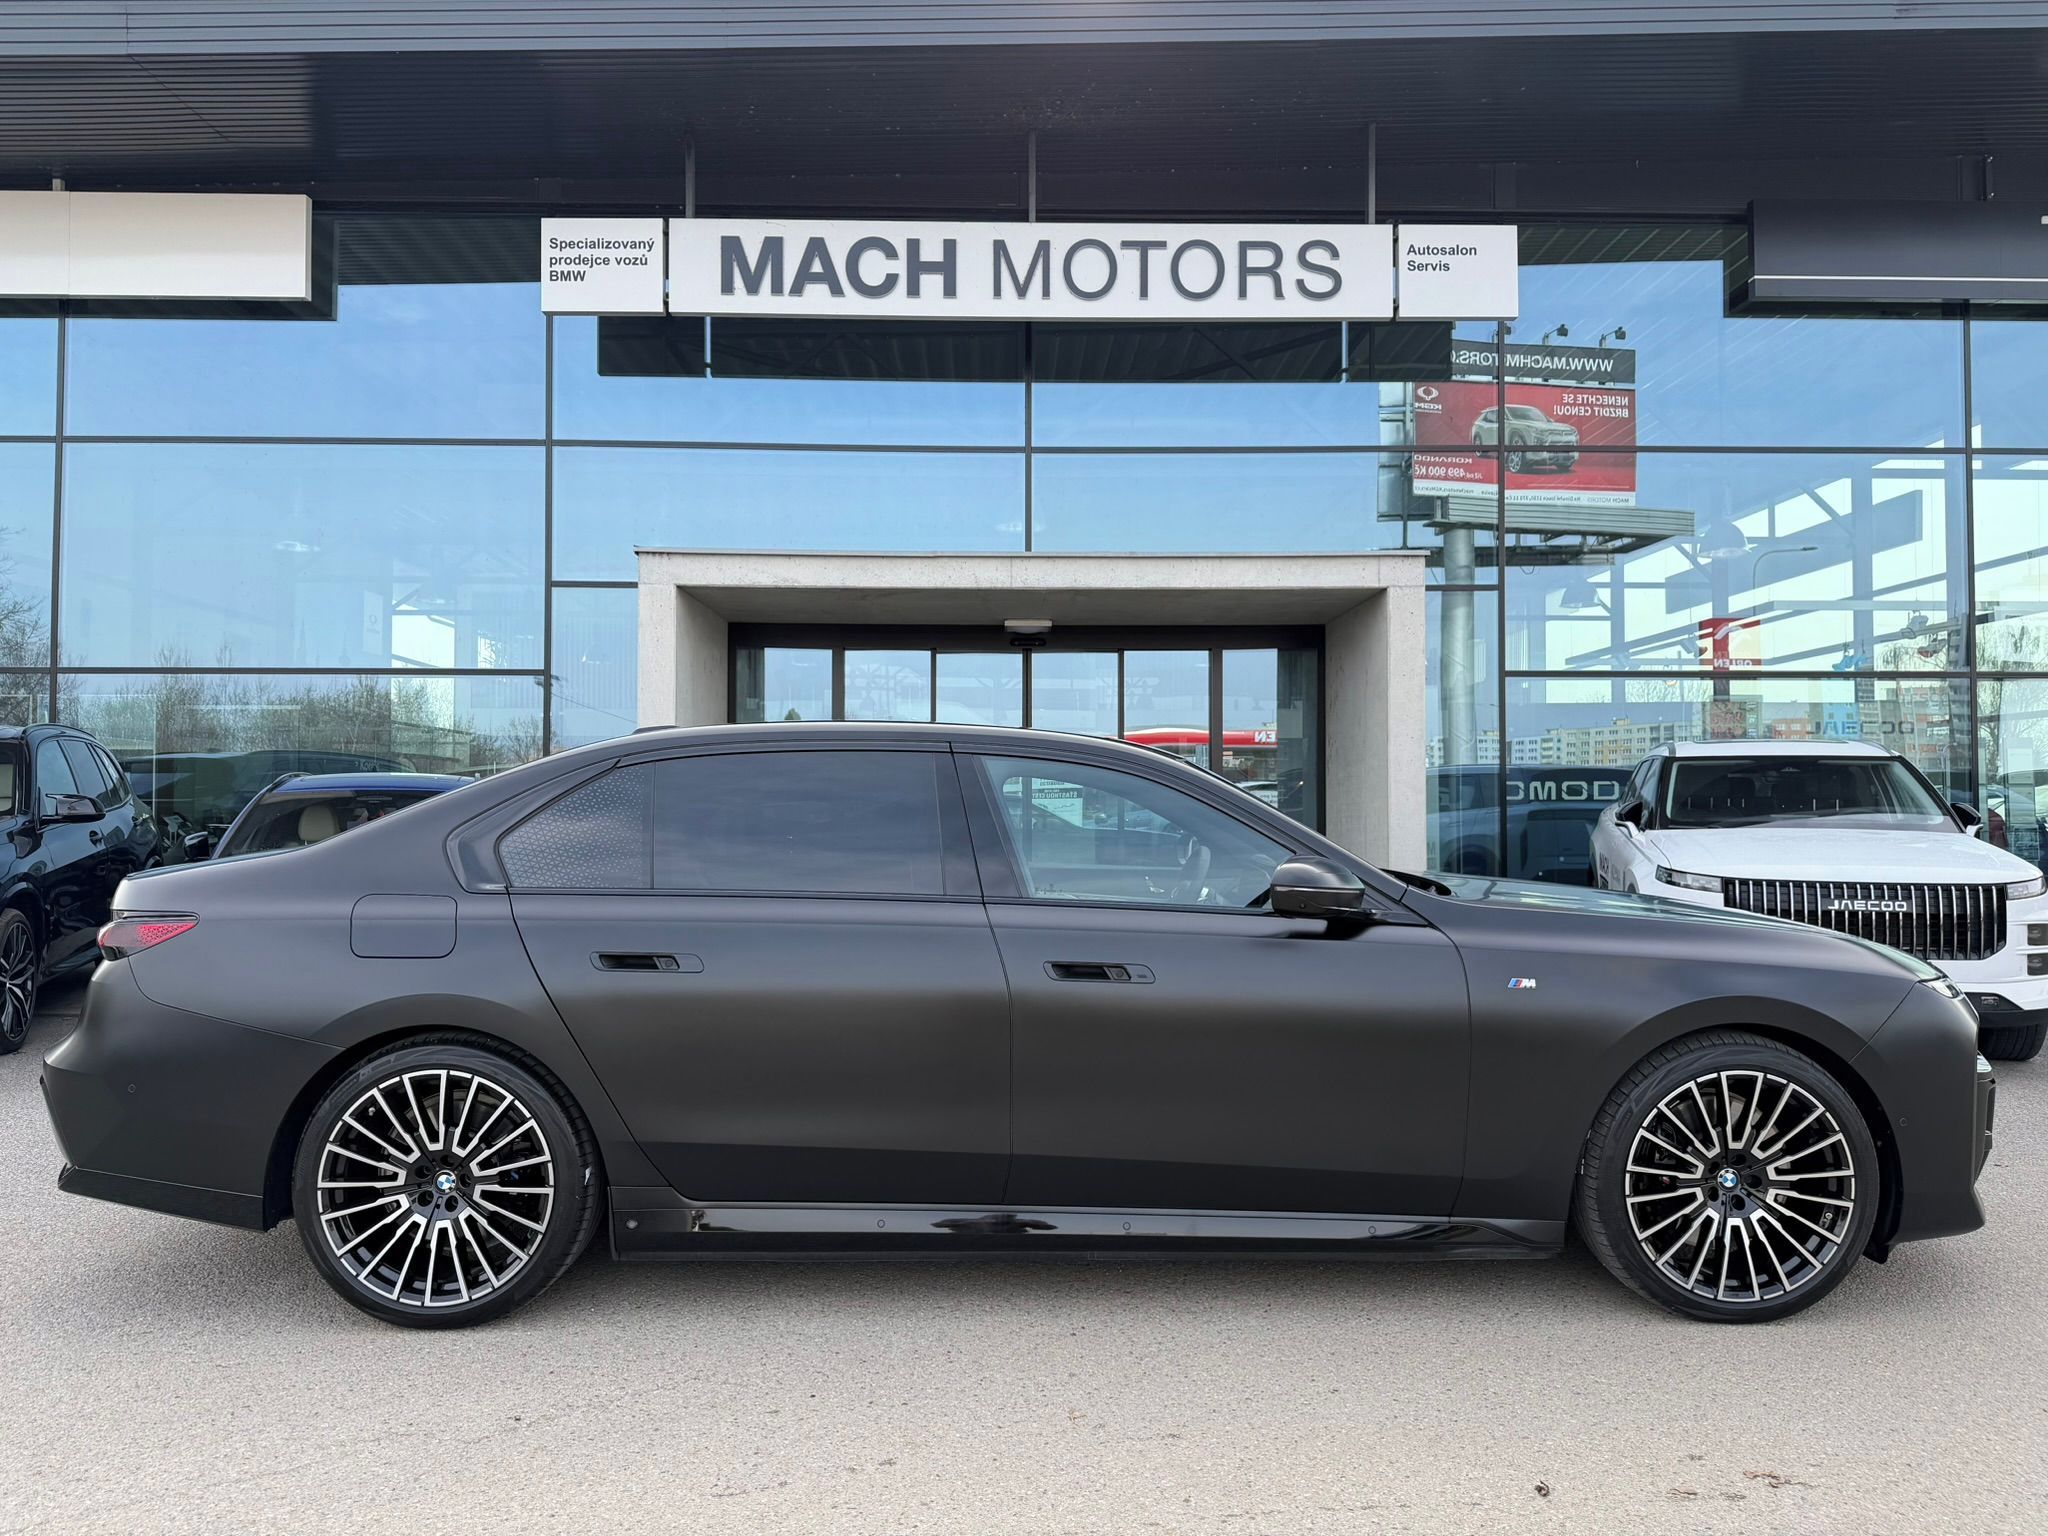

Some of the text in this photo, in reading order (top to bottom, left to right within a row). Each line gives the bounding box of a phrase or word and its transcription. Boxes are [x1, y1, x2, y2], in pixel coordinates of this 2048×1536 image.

[549, 236, 655, 254] Specializovaný
[1407, 243, 1478, 256] Autosalon
[549, 253, 648, 269] prodejce vozů
[1407, 260, 1451, 272] Servis
[720, 235, 1343, 302] MACH MOTORS
[549, 270, 586, 282] BMW
[1827, 900, 1907, 912] JAECOO
